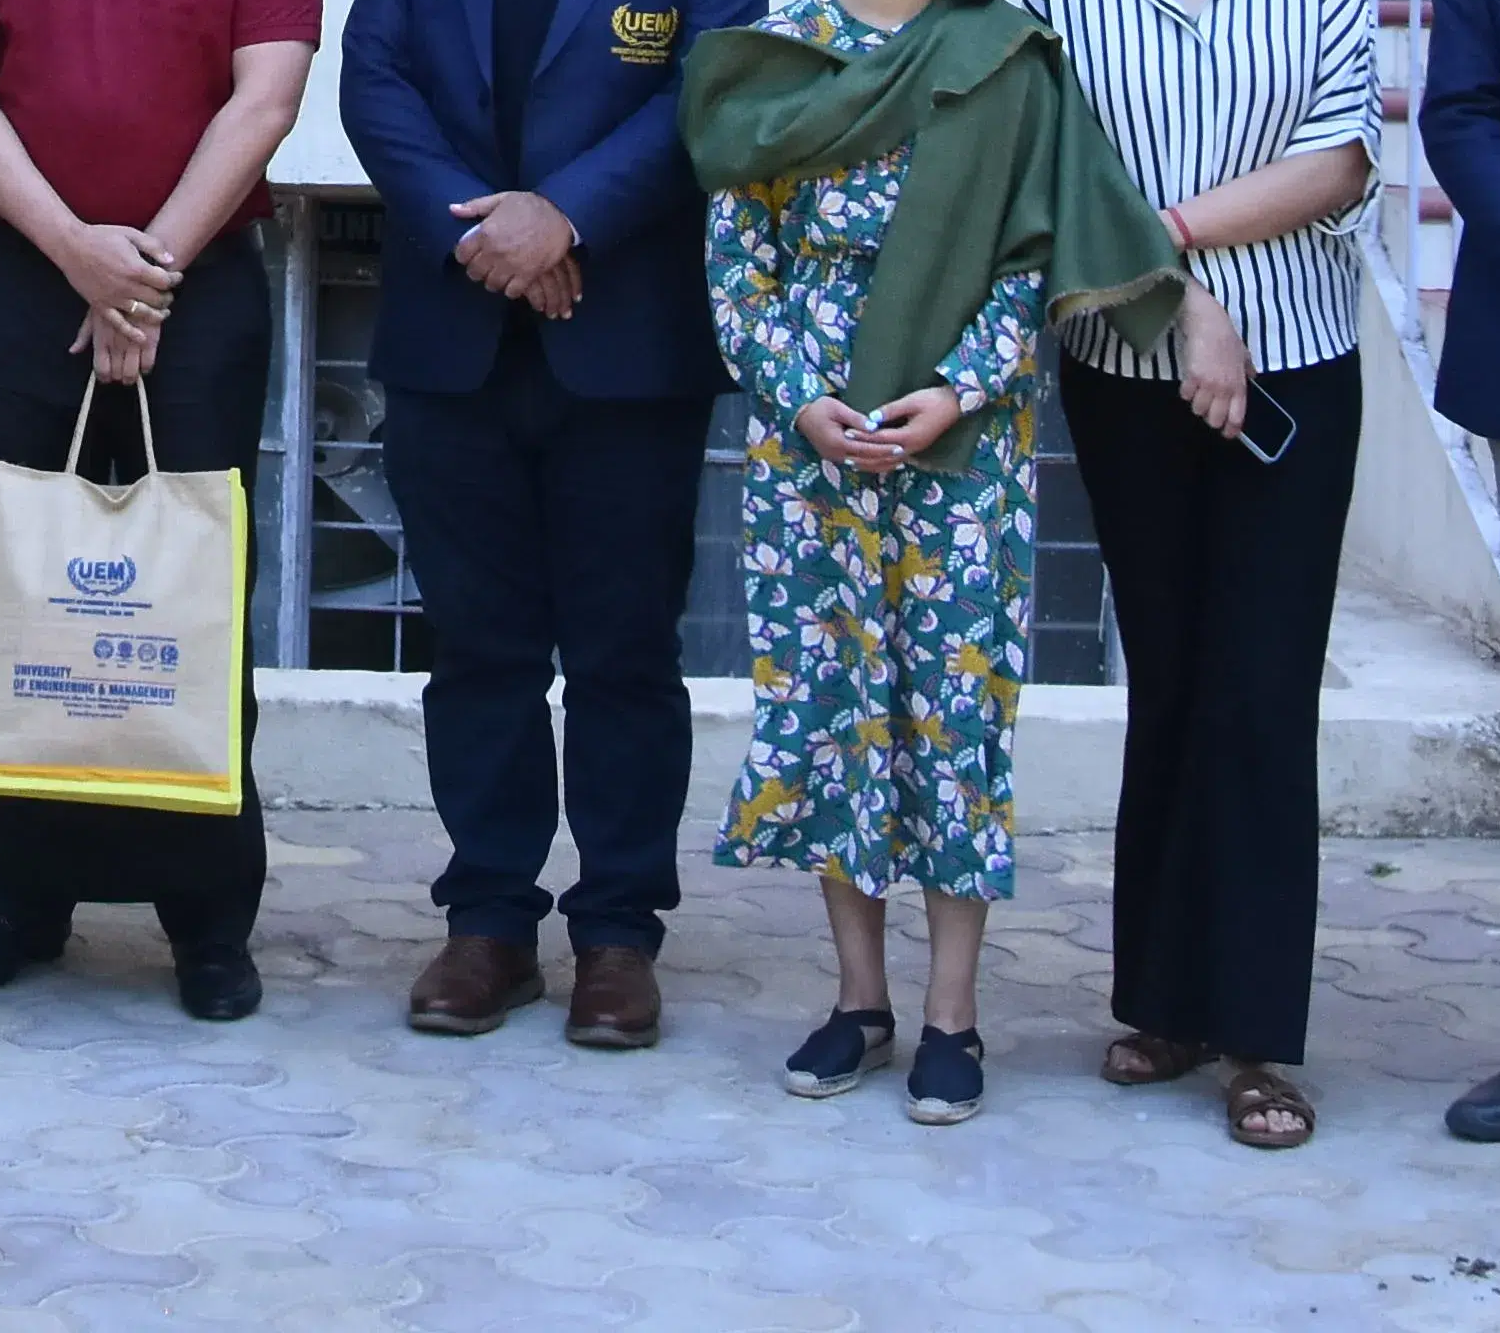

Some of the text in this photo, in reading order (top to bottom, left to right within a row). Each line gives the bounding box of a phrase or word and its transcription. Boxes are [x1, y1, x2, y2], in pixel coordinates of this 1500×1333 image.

[625, 12, 671, 32] UEM
[78, 561, 126, 581] UEM
[13, 663, 72, 679] UNIVERSITY
[13, 678, 25, 690] OF
[29, 679, 95, 694] ENGINEERING
[109, 684, 176, 699] MANAGEMENT
